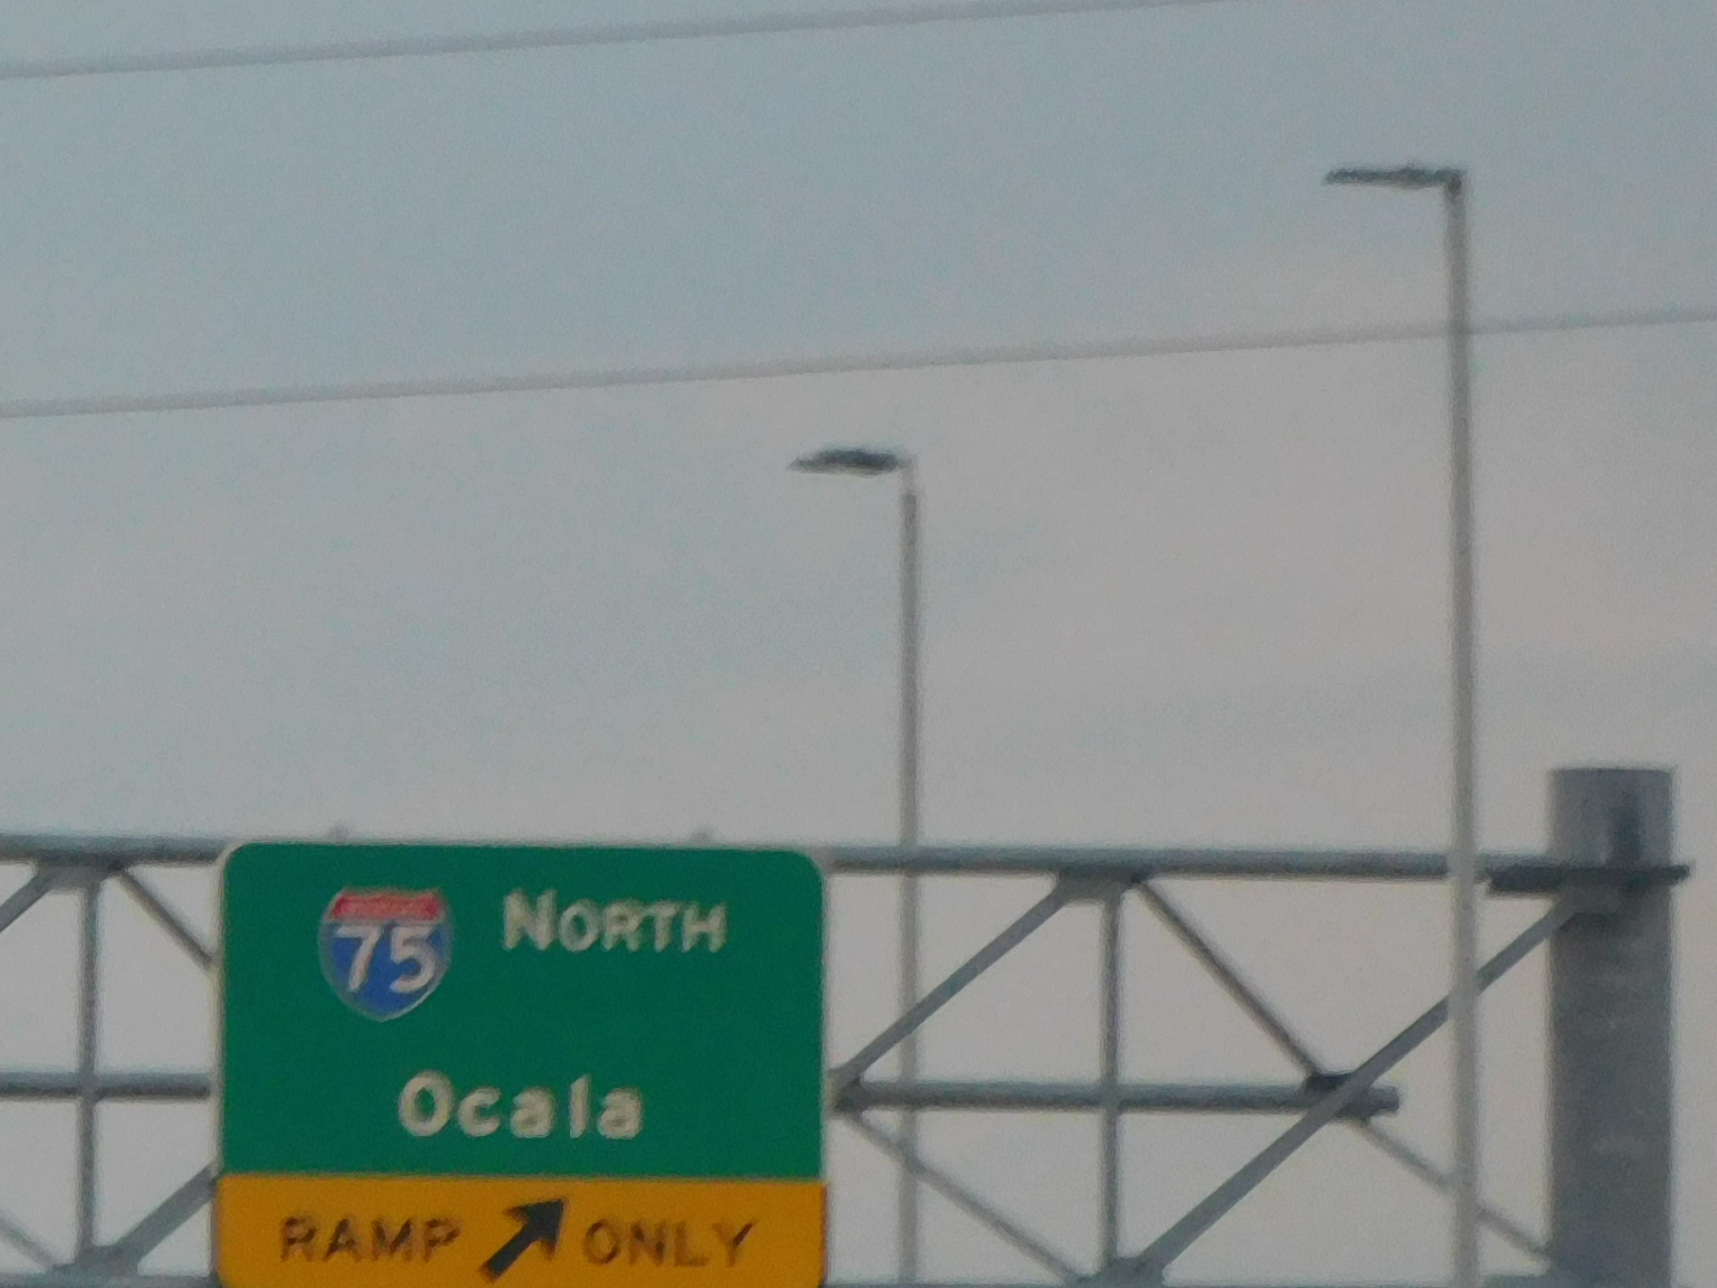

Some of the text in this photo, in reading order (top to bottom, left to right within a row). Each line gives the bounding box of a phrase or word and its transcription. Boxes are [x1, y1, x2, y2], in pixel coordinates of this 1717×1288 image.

[502, 887, 729, 953] NORTH
[334, 922, 438, 994] 75
[397, 1068, 645, 1139] Ocala
[279, 1215, 757, 1268] RAMP ONLY
